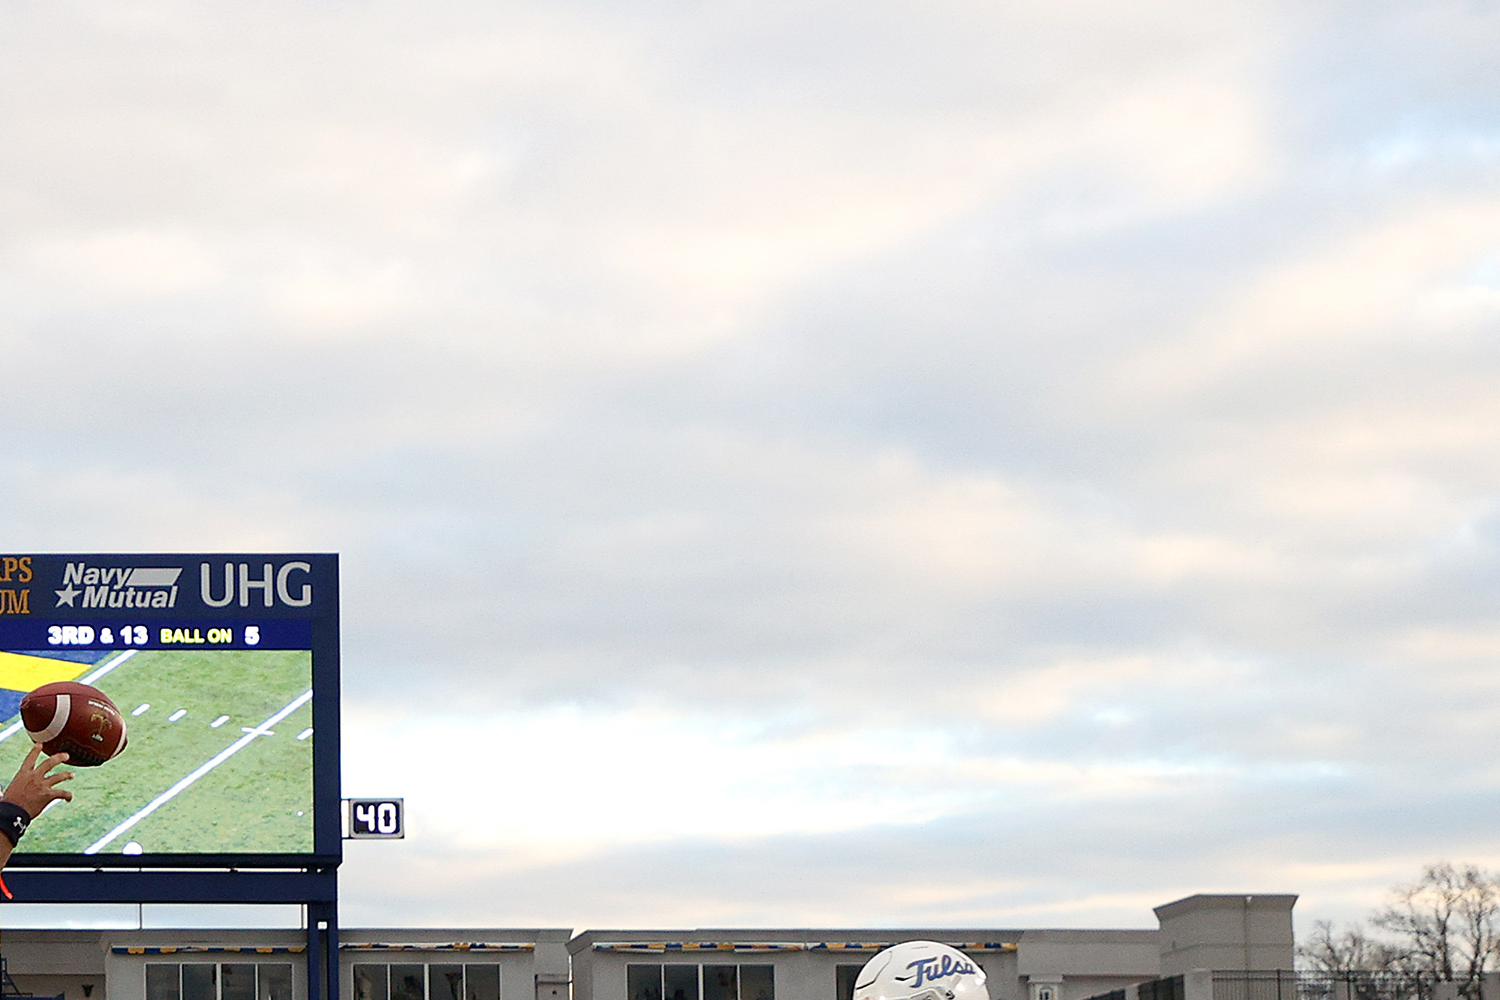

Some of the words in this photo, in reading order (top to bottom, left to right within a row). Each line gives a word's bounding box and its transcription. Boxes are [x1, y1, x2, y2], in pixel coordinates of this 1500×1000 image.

[63, 562, 133, 589] Navy
[200, 561, 312, 608] UHG
[82, 585, 179, 609] Mutual
[47, 625, 95, 645] 3RD
[100, 627, 115, 644] &
[119, 625, 149, 645] 13
[160, 628, 204, 644] BALL
[206, 628, 233, 644] ON
[244, 625, 261, 645] 5
[356, 802, 397, 833] 40
[906, 954, 976, 989] Tulsa
